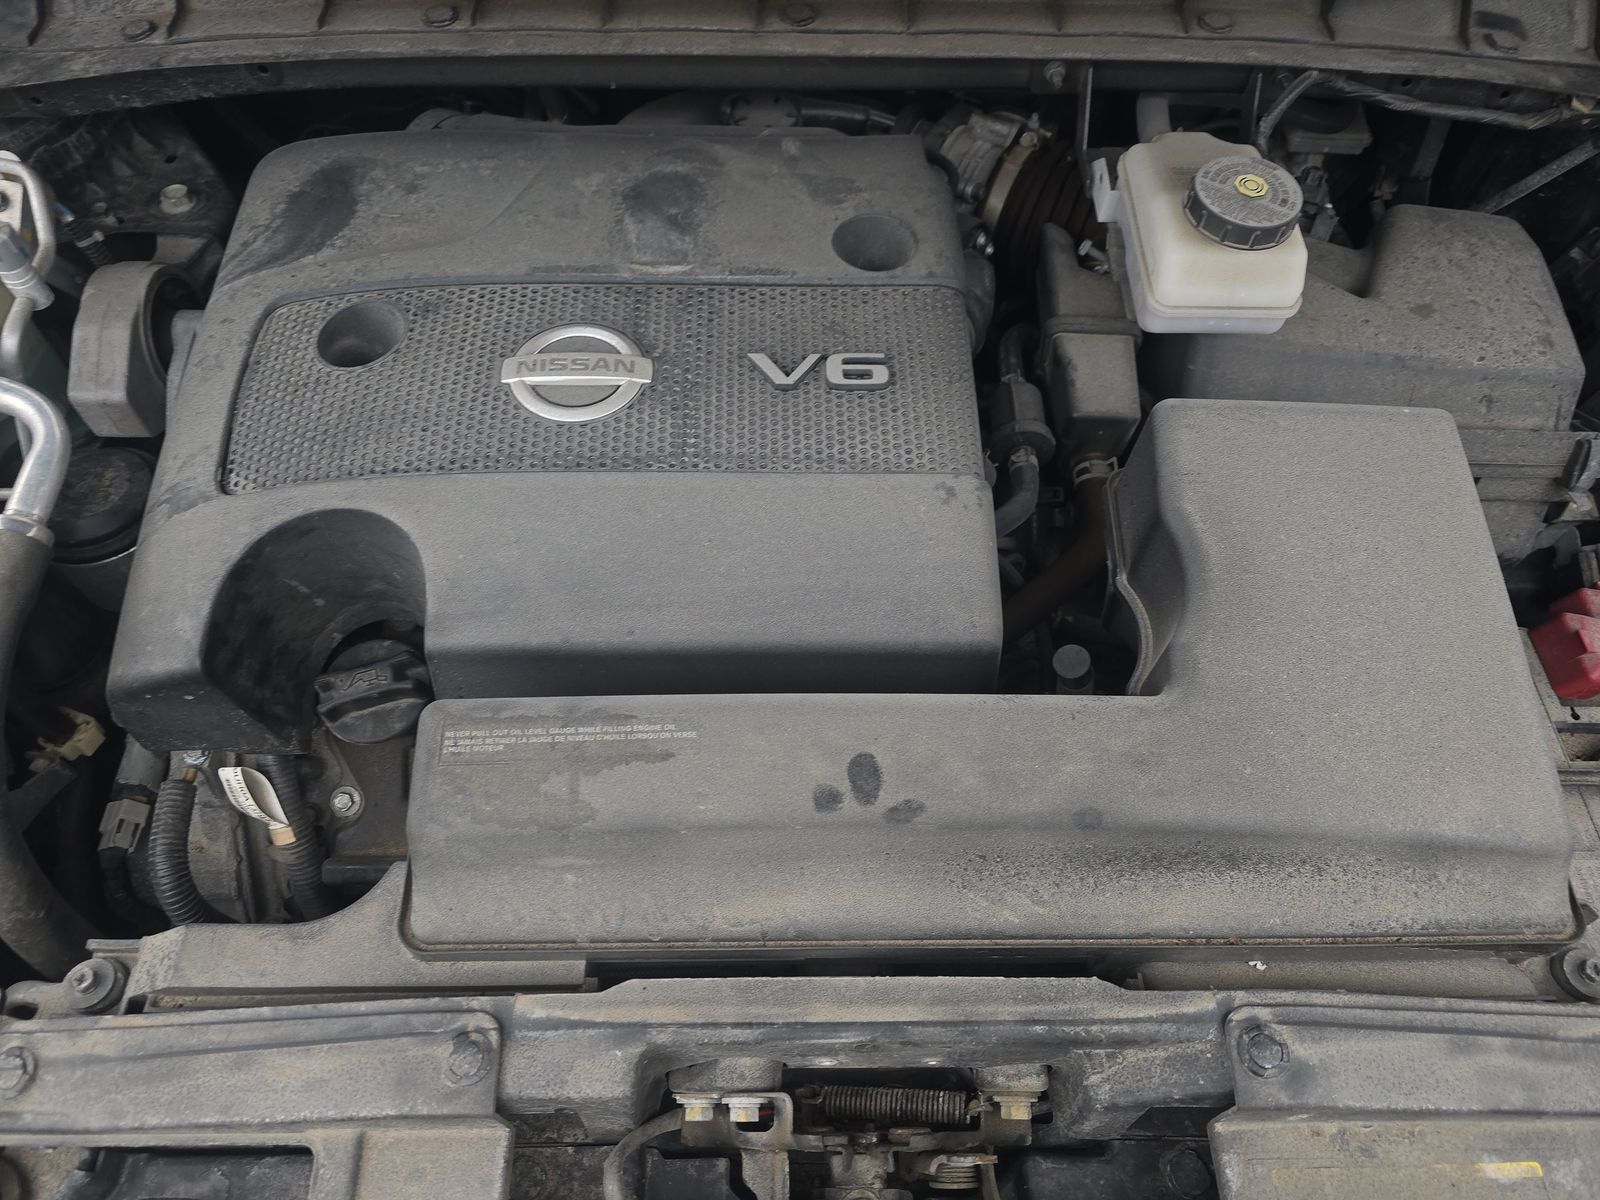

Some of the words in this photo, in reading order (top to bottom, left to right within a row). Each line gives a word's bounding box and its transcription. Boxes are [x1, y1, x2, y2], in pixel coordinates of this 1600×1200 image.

[515, 357, 636, 375] NISSAN
[747, 352, 890, 391] V6
[471, 729, 490, 737] PULL
[633, 724, 662, 732] ENGINE
[664, 723, 677, 731] OIL
